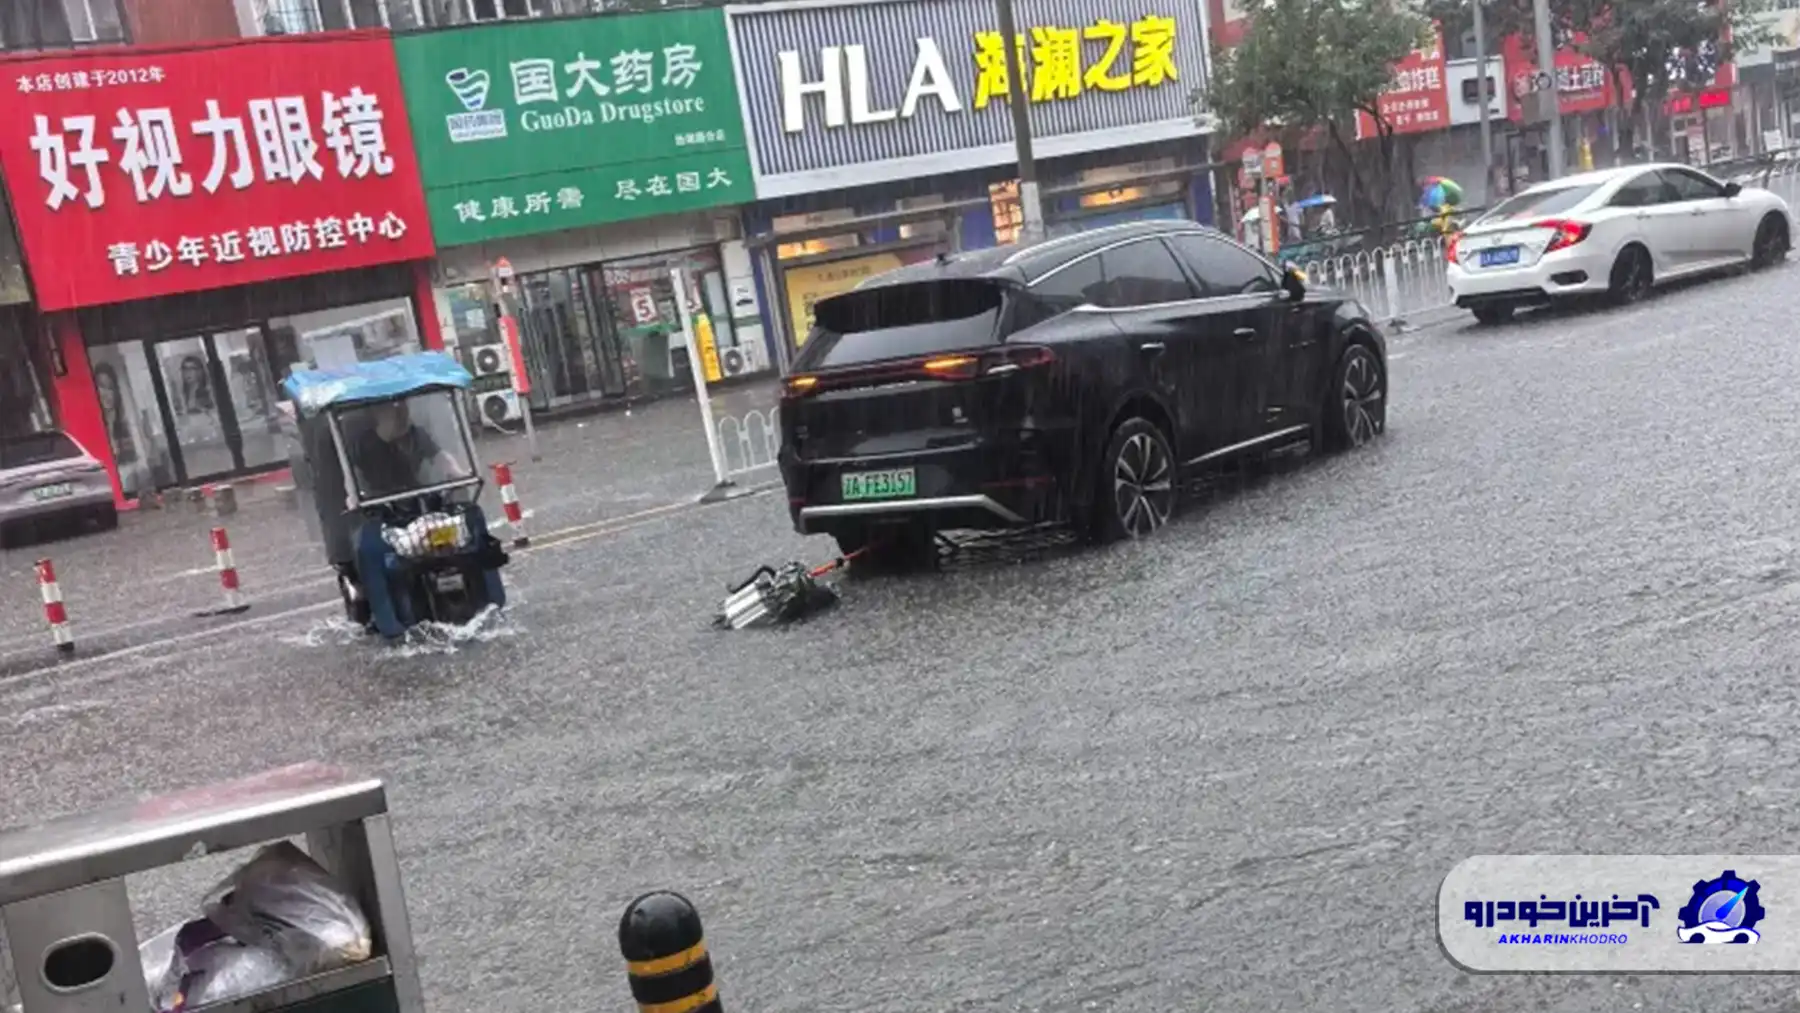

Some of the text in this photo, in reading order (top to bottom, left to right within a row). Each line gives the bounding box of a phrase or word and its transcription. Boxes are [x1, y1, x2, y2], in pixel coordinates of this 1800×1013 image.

[17, 66, 166, 93] 本店创建于2012年
[510, 43, 703, 104] 国大药房
[778, 38, 962, 133] HLA
[974, 15, 1178, 109] 海澜之家
[520, 96, 705, 132] GuoDa Drugstore
[29, 86, 396, 211] 好视力眼镜
[453, 167, 733, 223] 健康所需 尽在国大
[108, 211, 407, 276] 青少年近视防控中心
